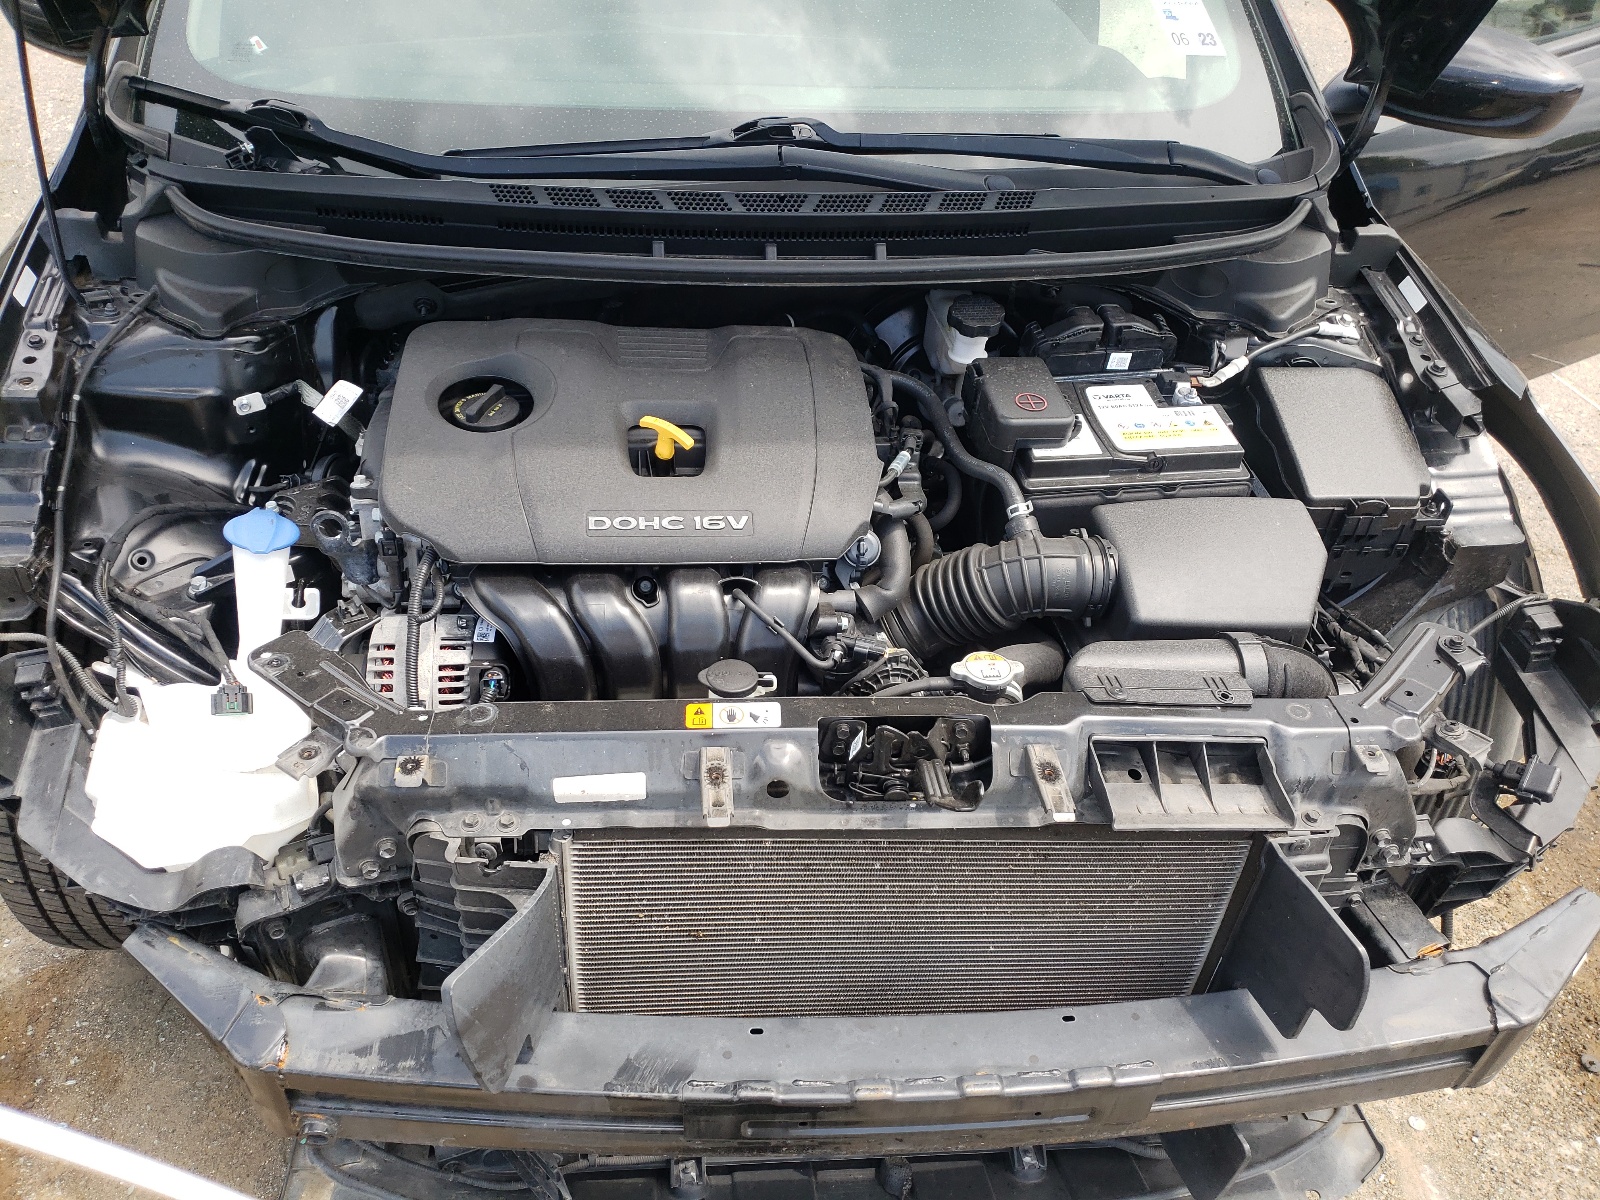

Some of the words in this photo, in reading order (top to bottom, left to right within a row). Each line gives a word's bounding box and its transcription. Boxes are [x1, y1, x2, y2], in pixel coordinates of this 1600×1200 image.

[1171, 32, 1190, 46] 06
[1197, 32, 1217, 46] 23
[588, 516, 685, 530] DOHC
[693, 515, 749, 530] 16V
